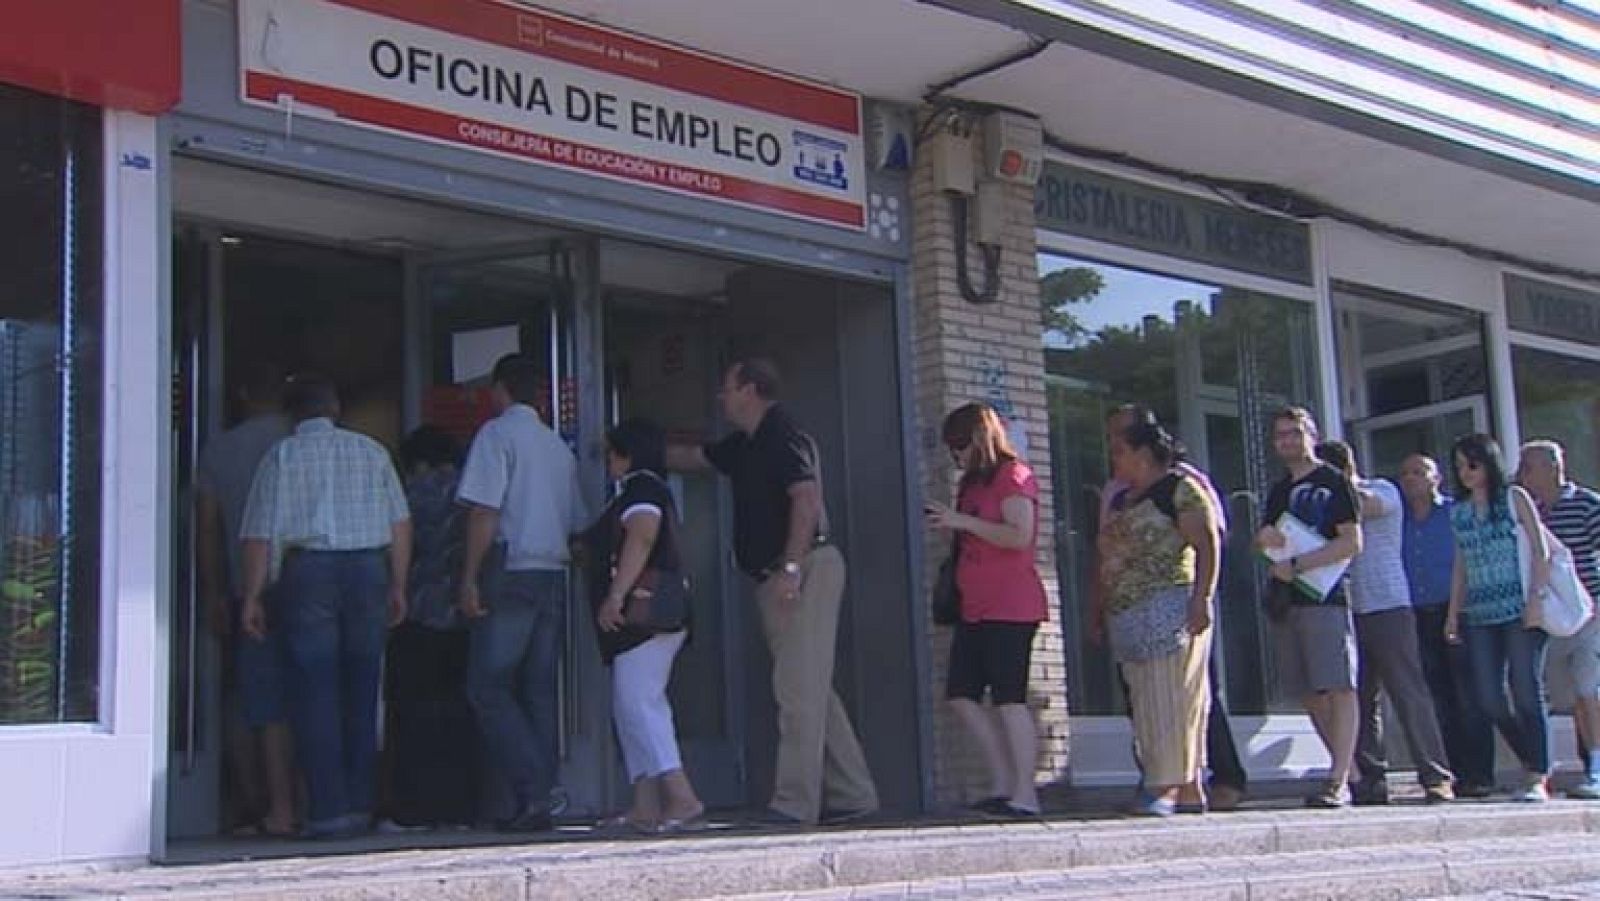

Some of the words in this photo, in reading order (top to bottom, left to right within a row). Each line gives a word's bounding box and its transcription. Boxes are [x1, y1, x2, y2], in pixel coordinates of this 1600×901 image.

[369, 38, 553, 116] OFICINA
[565, 84, 618, 131] DE
[630, 100, 782, 167] EMPLEO
[553, 142, 574, 162] DE
[669, 169, 722, 192] EMPLEO
